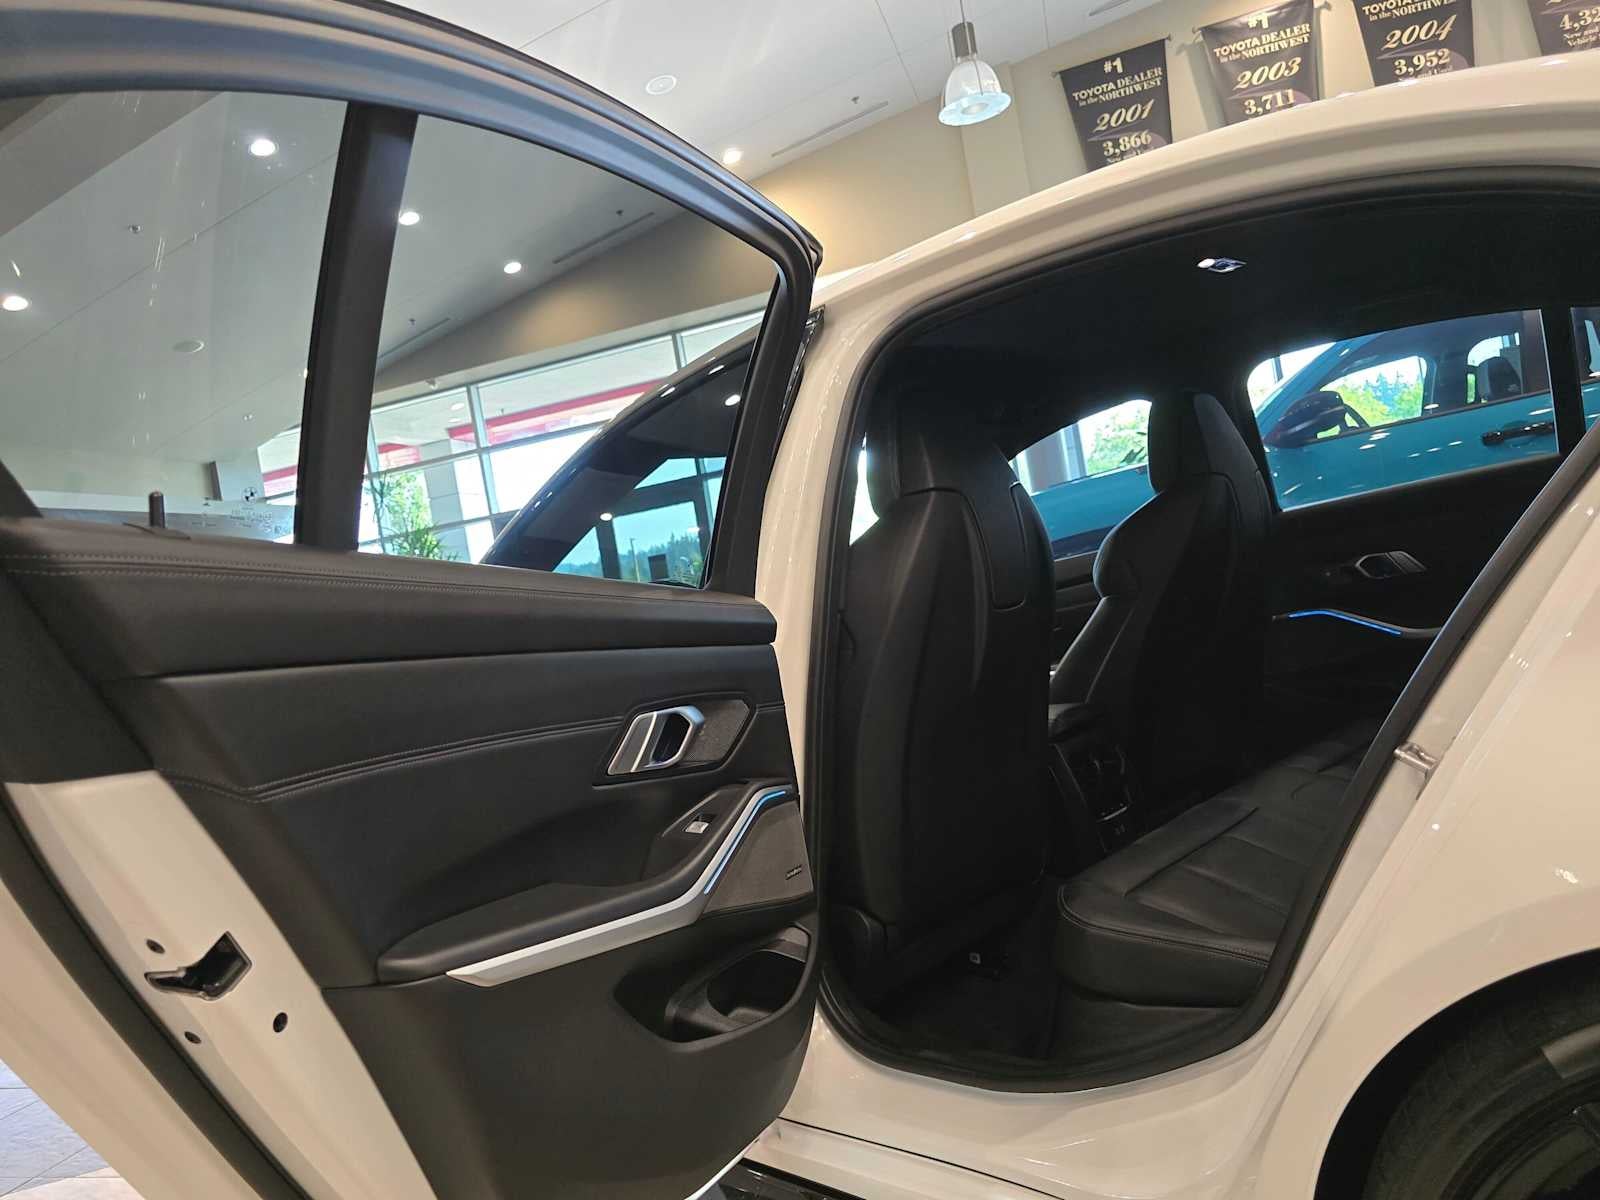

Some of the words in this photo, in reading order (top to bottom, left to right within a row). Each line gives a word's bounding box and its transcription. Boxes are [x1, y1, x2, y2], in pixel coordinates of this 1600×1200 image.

[1247, 12, 1269, 29] #1
[1381, 14, 1457, 51] 2004
[1213, 37, 1261, 57] TOYOTA
[1261, 23, 1311, 44] DEALER
[1229, 53, 1240, 61] the
[1241, 34, 1310, 60] NORTHWEST
[1103, 57, 1123, 74] #1
[1232, 57, 1302, 91] 2003
[1393, 48, 1451, 75] 3,952
[1072, 82, 1117, 101] TOYOTA
[1117, 67, 1163, 88] DEALER
[1087, 97, 1098, 105] the
[1099, 77, 1163, 103] NORTHWEST
[1244, 88, 1295, 115] 3,711
[1093, 99, 1155, 132] 2001
[1103, 130, 1152, 157] 3,866
